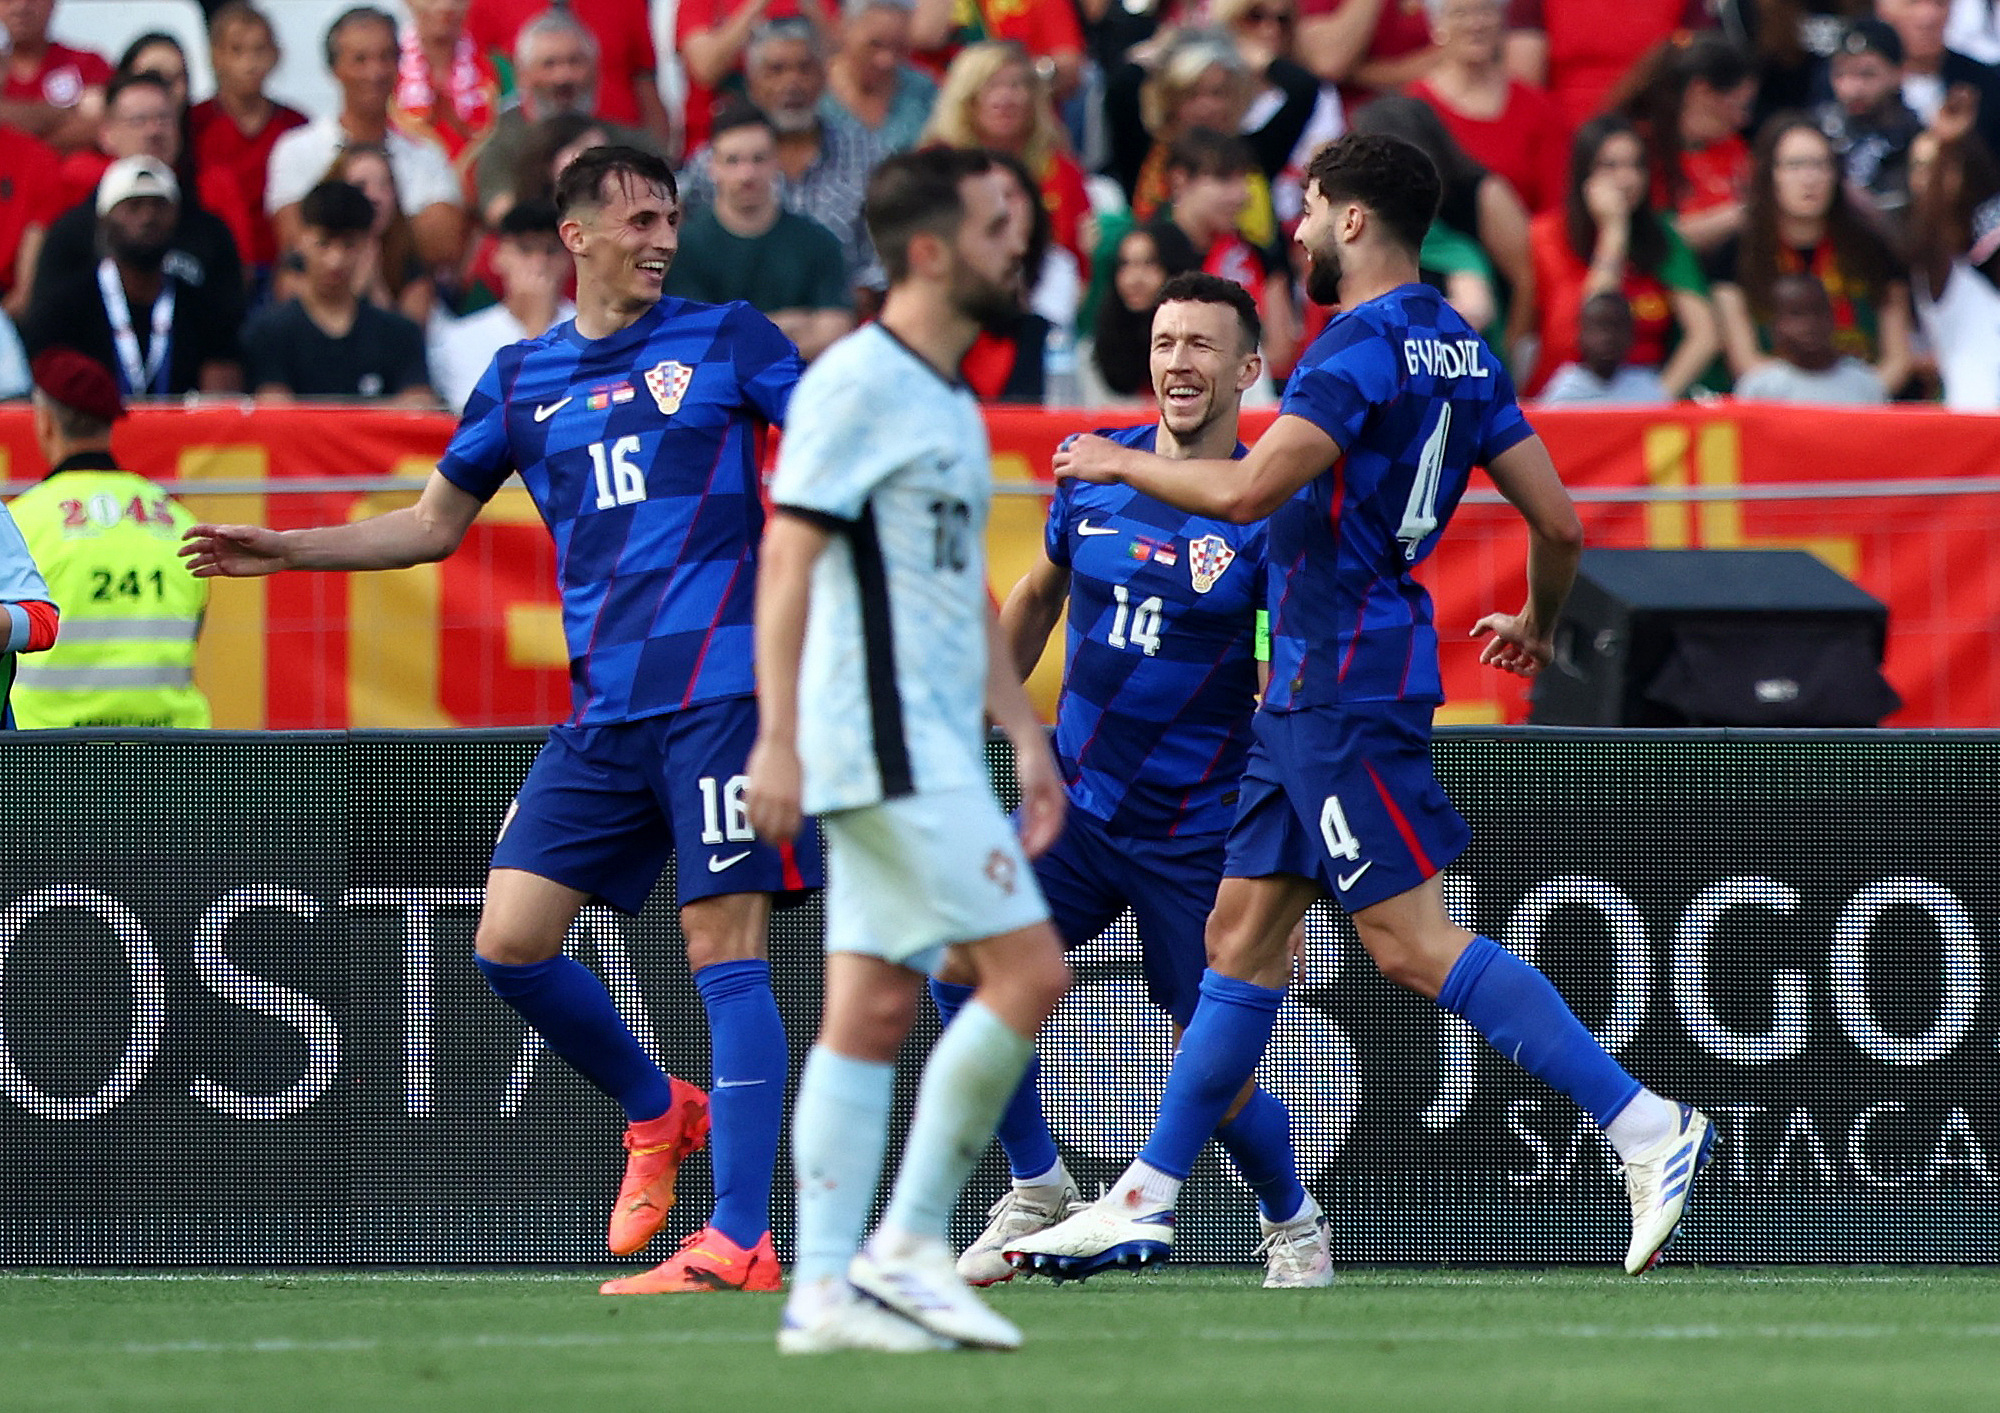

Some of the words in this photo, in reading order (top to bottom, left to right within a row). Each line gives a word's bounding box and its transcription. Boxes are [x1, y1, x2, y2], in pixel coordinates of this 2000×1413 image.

[587, 434, 648, 511] 16
[1396, 401, 1452, 561] 4
[91, 567, 164, 602] 241
[1107, 584, 1164, 657] 14
[698, 775, 756, 846] 16
[1319, 795, 1361, 862] 4
